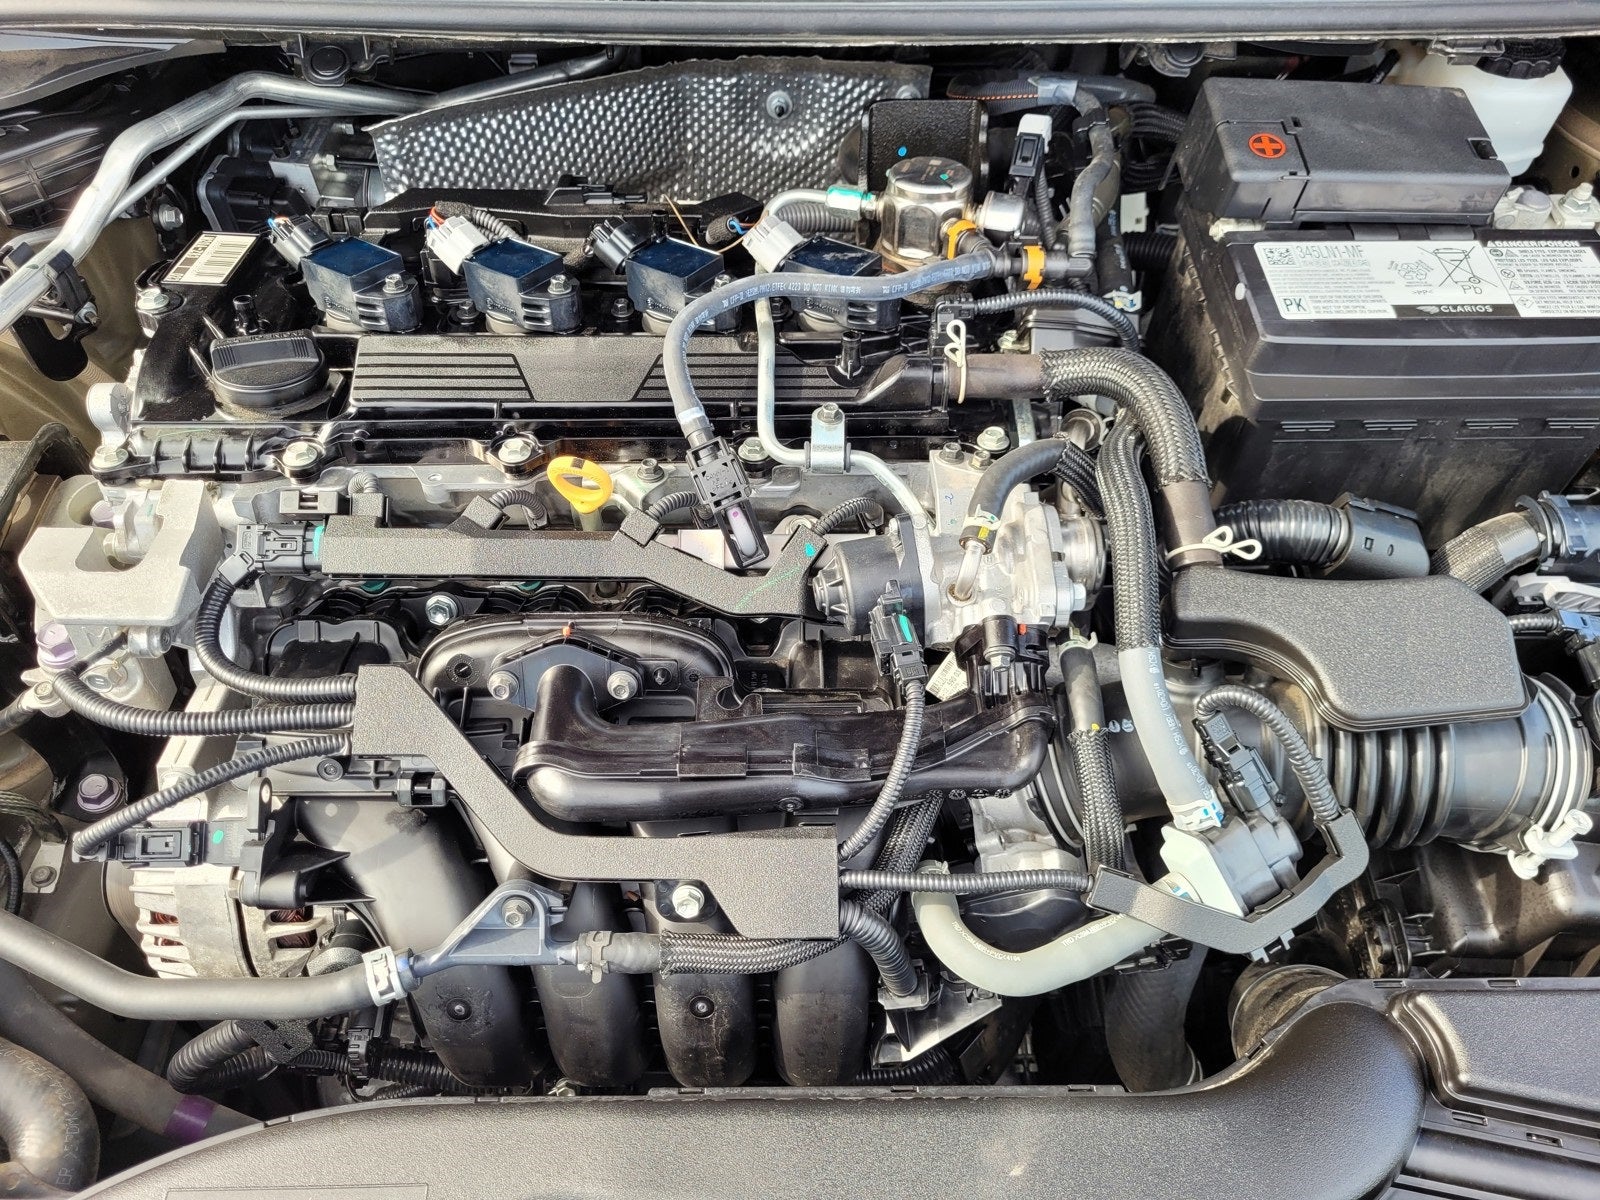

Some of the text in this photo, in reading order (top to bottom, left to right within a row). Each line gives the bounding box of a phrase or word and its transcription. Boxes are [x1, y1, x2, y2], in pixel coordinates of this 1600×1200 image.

[1296, 244, 1364, 259] 345LN1-MF
[803, 282, 811, 292] DO
[1460, 284, 1482, 295] Pb
[1283, 298, 1307, 313] PK
[1440, 305, 1493, 313] CLARIOS
